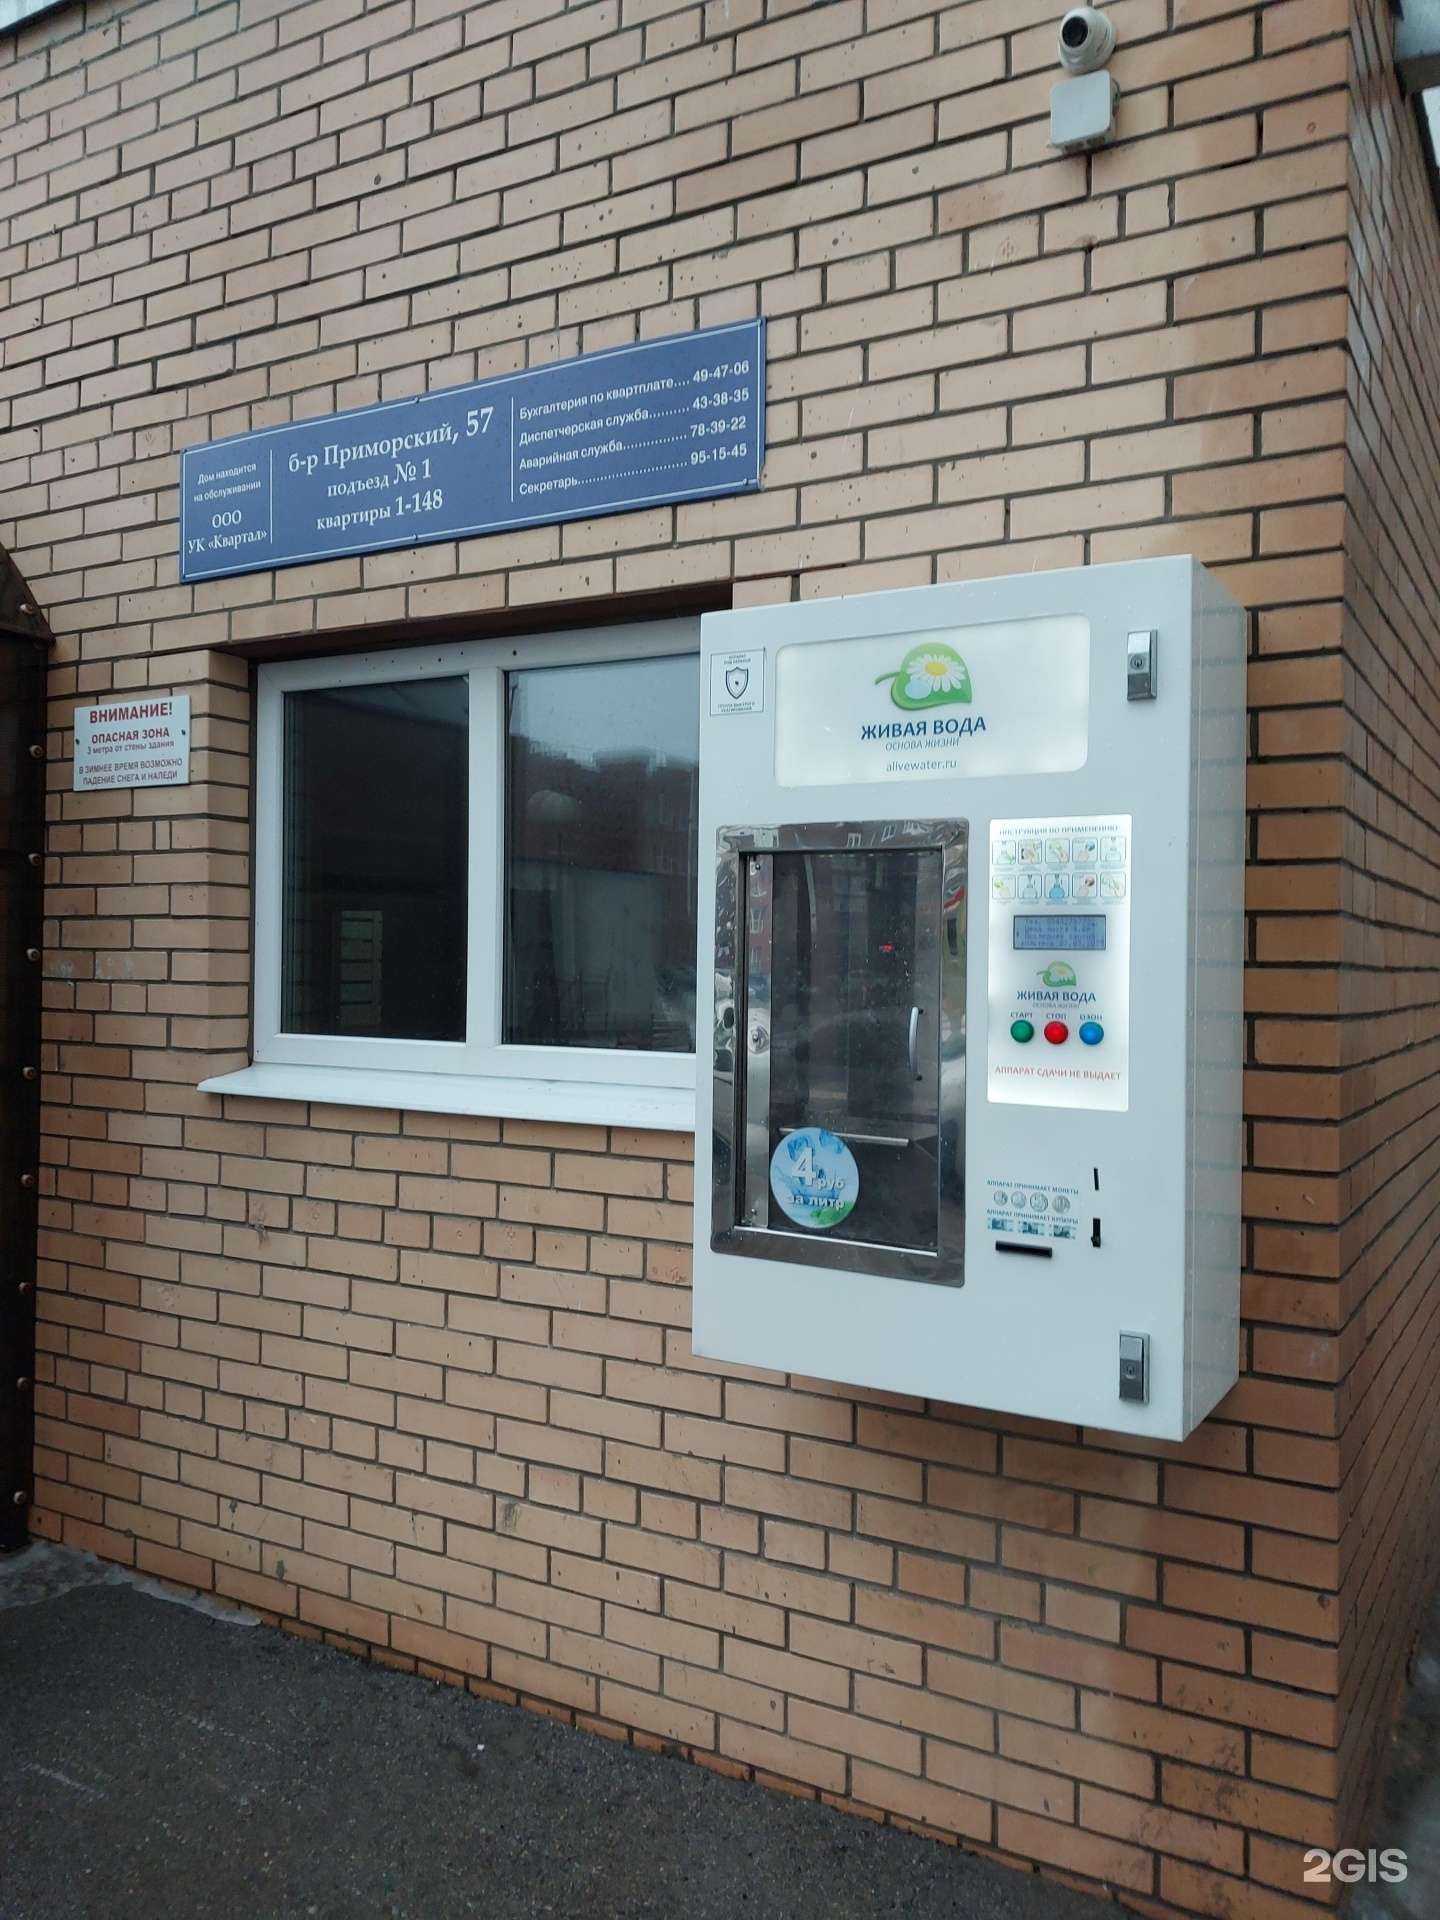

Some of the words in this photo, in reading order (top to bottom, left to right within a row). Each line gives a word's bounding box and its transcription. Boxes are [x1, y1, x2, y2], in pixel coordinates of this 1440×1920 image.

[519, 393, 588, 421] Бухгалтерия
[590, 391, 604, 406] по
[606, 376, 673, 402] квартплате
[692, 360, 750, 383] 49-47-06
[519, 417, 603, 447] Диспетчерская
[605, 409, 648, 428] служба
[692, 387, 750, 410] 43-38-35
[288, 453, 319, 475] б-р
[323, 422, 459, 469] Приморский,
[466, 405, 495, 437] 57
[519, 447, 579, 471] Аварийная
[581, 439, 623, 460] служба
[690, 417, 747, 439] 78-39-22
[197, 473, 215, 485] Дом
[216, 463, 257, 479] находится
[327, 474, 390, 497] подъезд
[393, 461, 417, 485] №
[422, 458, 432, 479] 1
[519, 475, 578, 497] Секретарь
[690, 443, 747, 466] 95-15-45
[193, 493, 203, 502] на
[204, 480, 262, 501] обслуживании
[212, 509, 242, 529] ООО
[317, 505, 391, 531] квартиры
[395, 488, 443, 516] 1-148
[188, 538, 206, 554] УК
[208, 529, 268, 550] «Квартал»
[89, 702, 173, 724] ВНИМАНИЕ!
[91, 729, 139, 744] ОПАСНАЯ
[142, 727, 170, 739] ЗОНА
[861, 721, 927, 741] ЖИВАЯ
[933, 716, 986, 737] ВОДА
[87, 746, 92, 755] 3
[93, 745, 113, 754] метра
[115, 744, 123, 752] от
[124, 743, 147, 752] стены
[149, 741, 175, 749] здания
[885, 740, 923, 751] ОСНОВА
[924, 738, 960, 749] ЖИЗНИ
[79, 766, 84, 774] В
[85, 763, 112, 774] ЗИМНЕЕ
[114, 761, 139, 771] ВРЕМЯ
[140, 758, 183, 769] ВОЗМОЖНО
[886, 760, 957, 772] alivewater.ru
[82, 775, 115, 785] ПАДЕНИЕ
[117, 773, 140, 783] СНЕГА
[141, 772, 147, 781] И
[148, 770, 178, 781] НАЛЕДИ
[1016, 990, 1059, 1001] ЖИВАЯ
[1063, 991, 1097, 1004] ВОДА
[1046, 1012, 1067, 1020] СТОП
[995, 1064, 1035, 1075] АППАРАТ
[1037, 1067, 1067, 1078] СДАЧИ
[1069, 1068, 1081, 1077] НЕ
[1083, 1069, 1121, 1081] ВЫДАЕТ
[792, 1147, 817, 1187] 4
[817, 1175, 844, 1190] руб
[810, 1196, 845, 1211] литр
